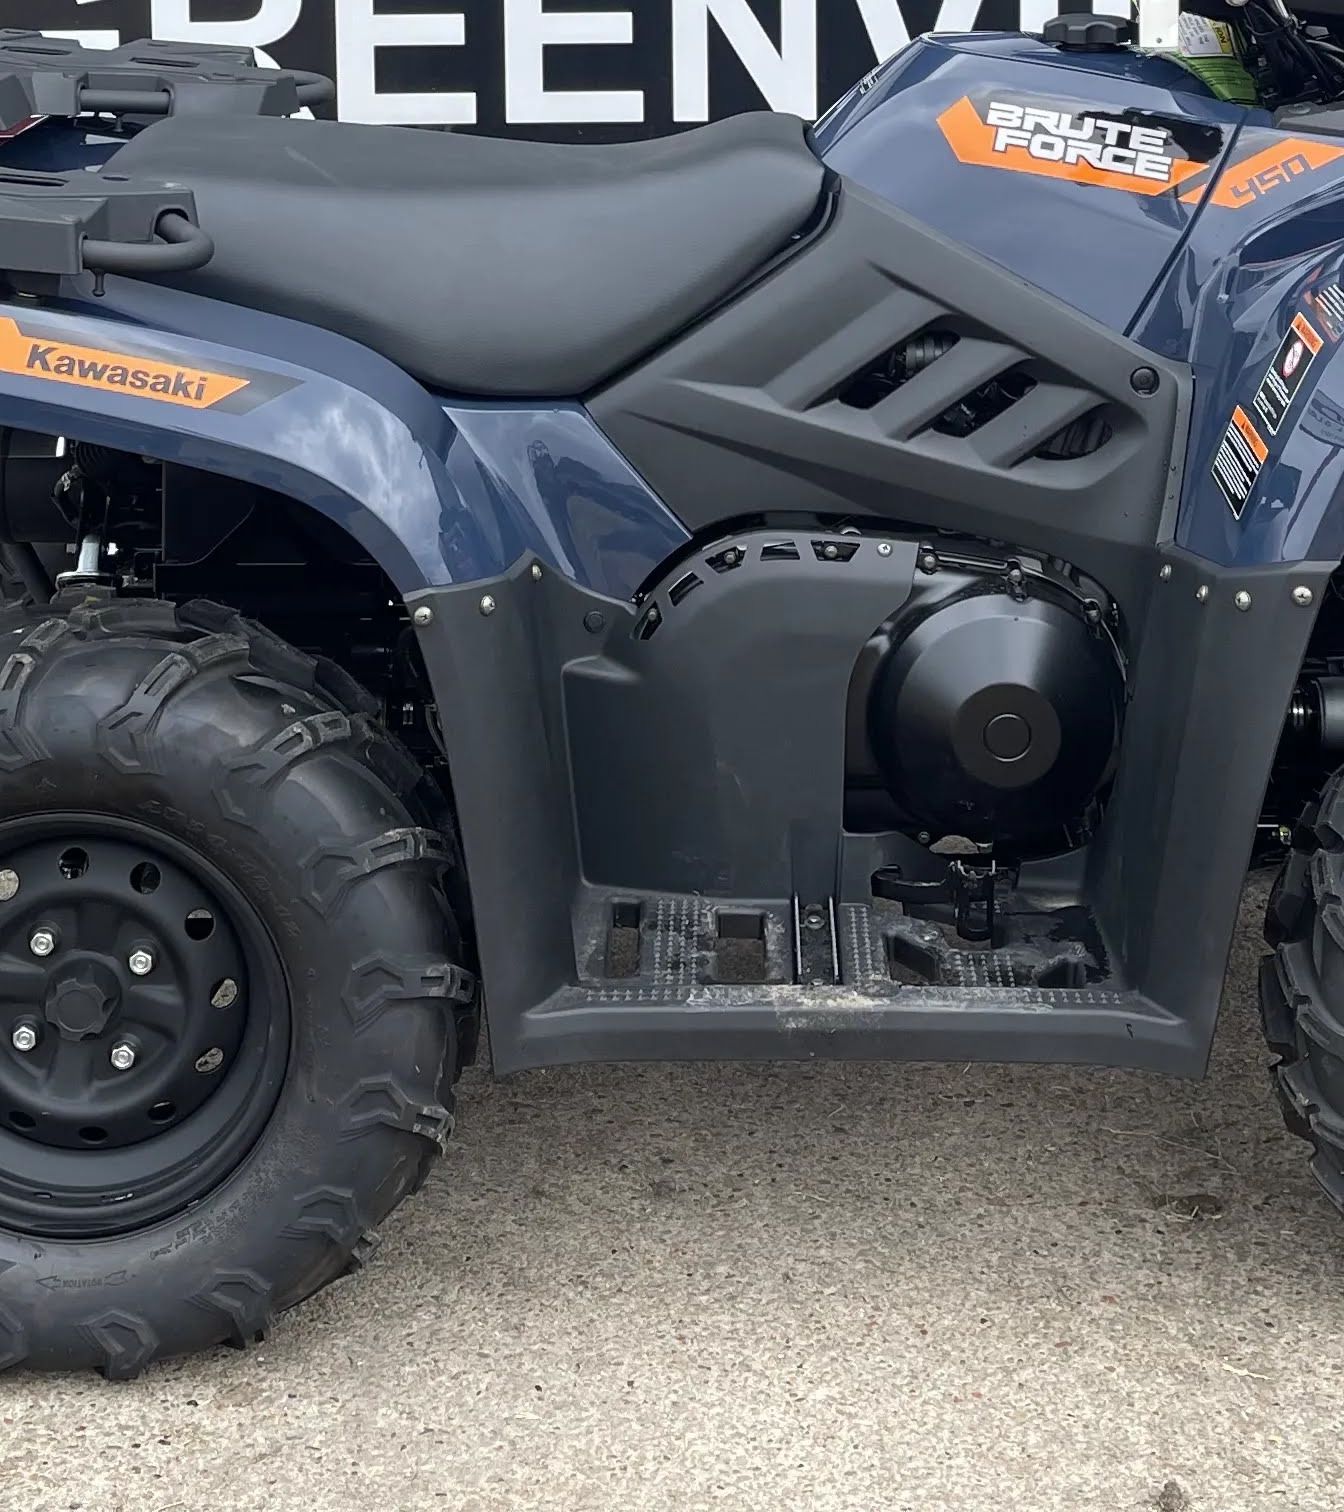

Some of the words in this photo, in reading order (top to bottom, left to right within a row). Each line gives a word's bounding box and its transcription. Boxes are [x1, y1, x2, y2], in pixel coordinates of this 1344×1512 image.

[986, 100, 1168, 155] BRUTE
[993, 125, 1175, 181] FORCE
[1229, 153, 1315, 199] 450
[25, 343, 208, 401] Kawasaki
